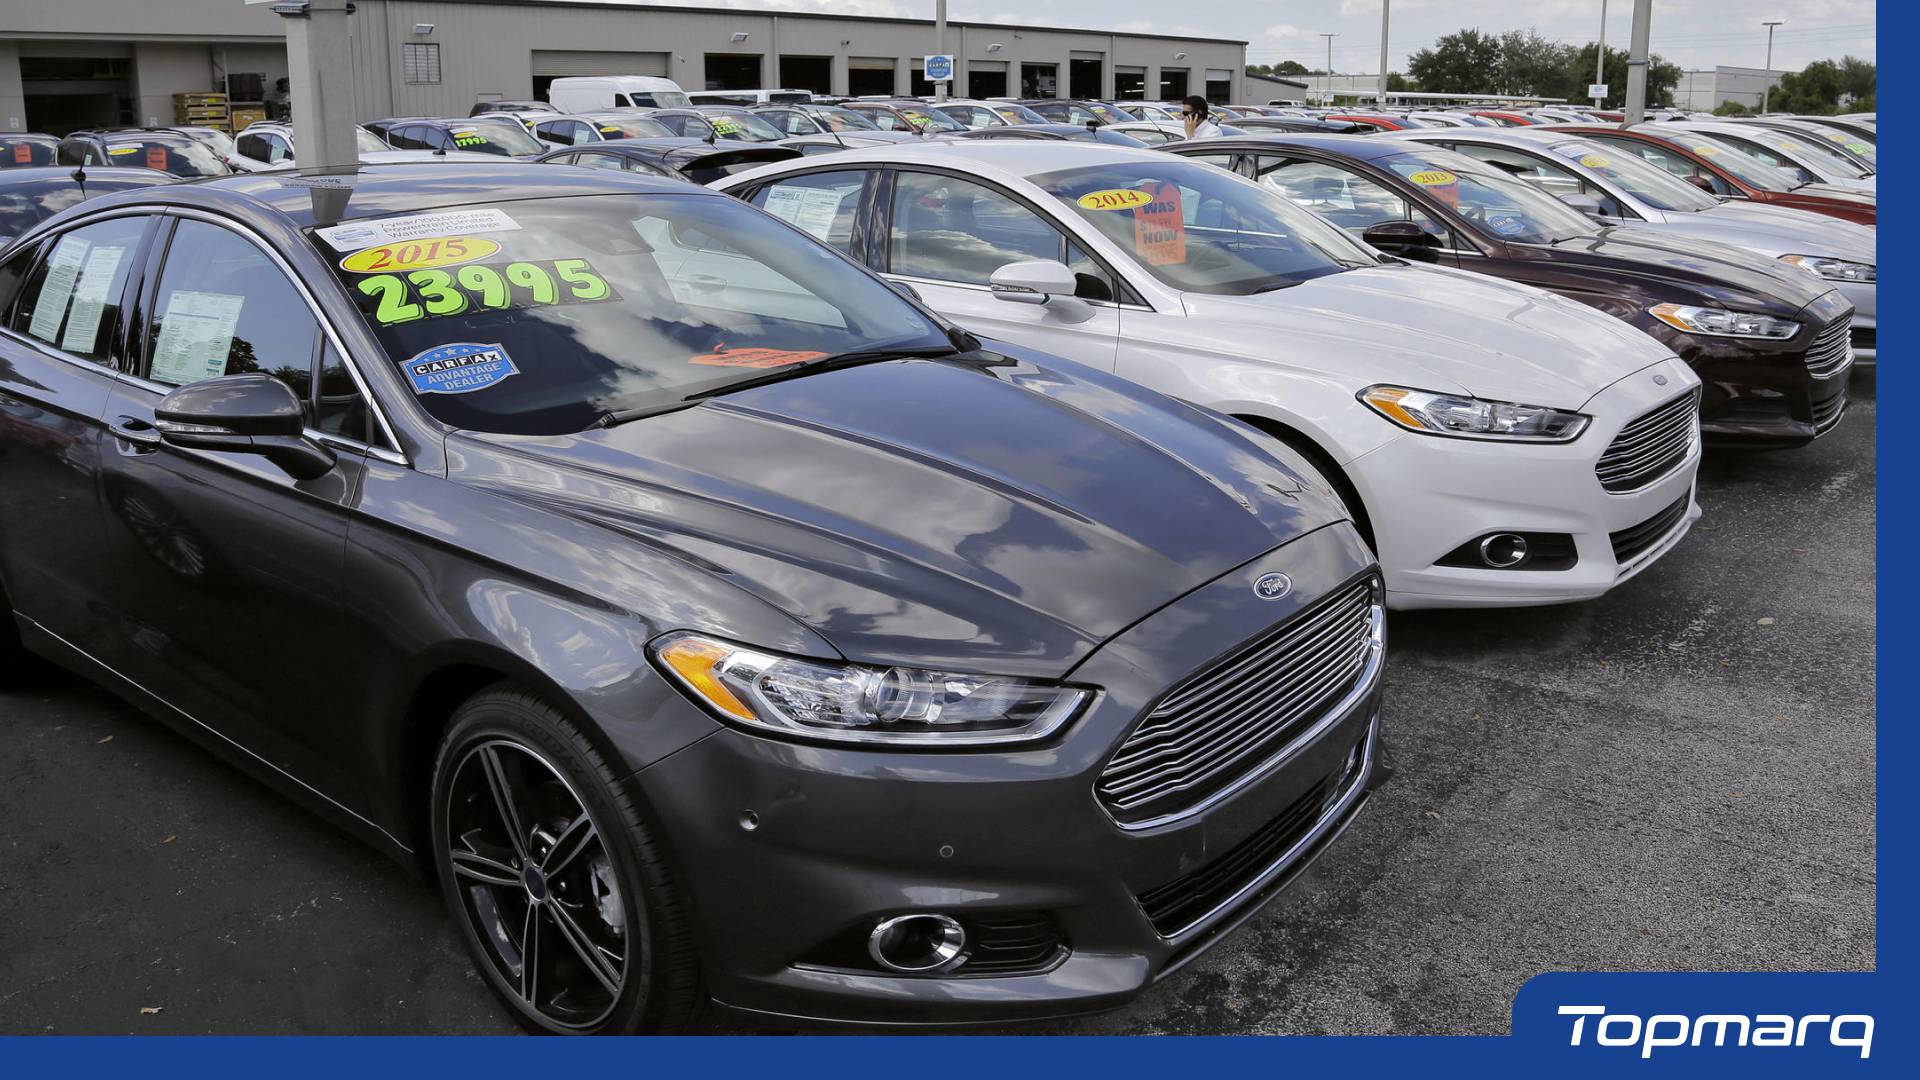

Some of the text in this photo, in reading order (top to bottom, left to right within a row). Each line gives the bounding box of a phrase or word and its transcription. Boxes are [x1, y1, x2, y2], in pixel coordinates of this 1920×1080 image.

[1418, 173, 1448, 184] 2013
[1088, 191, 1140, 209] 2014
[1143, 201, 1176, 214] WAS
[367, 238, 469, 271] 2015
[357, 259, 611, 324] 23995
[415, 353, 500, 375] CARFAX
[427, 362, 501, 385] ADVANTAGE
[444, 374, 494, 390] DEALER
